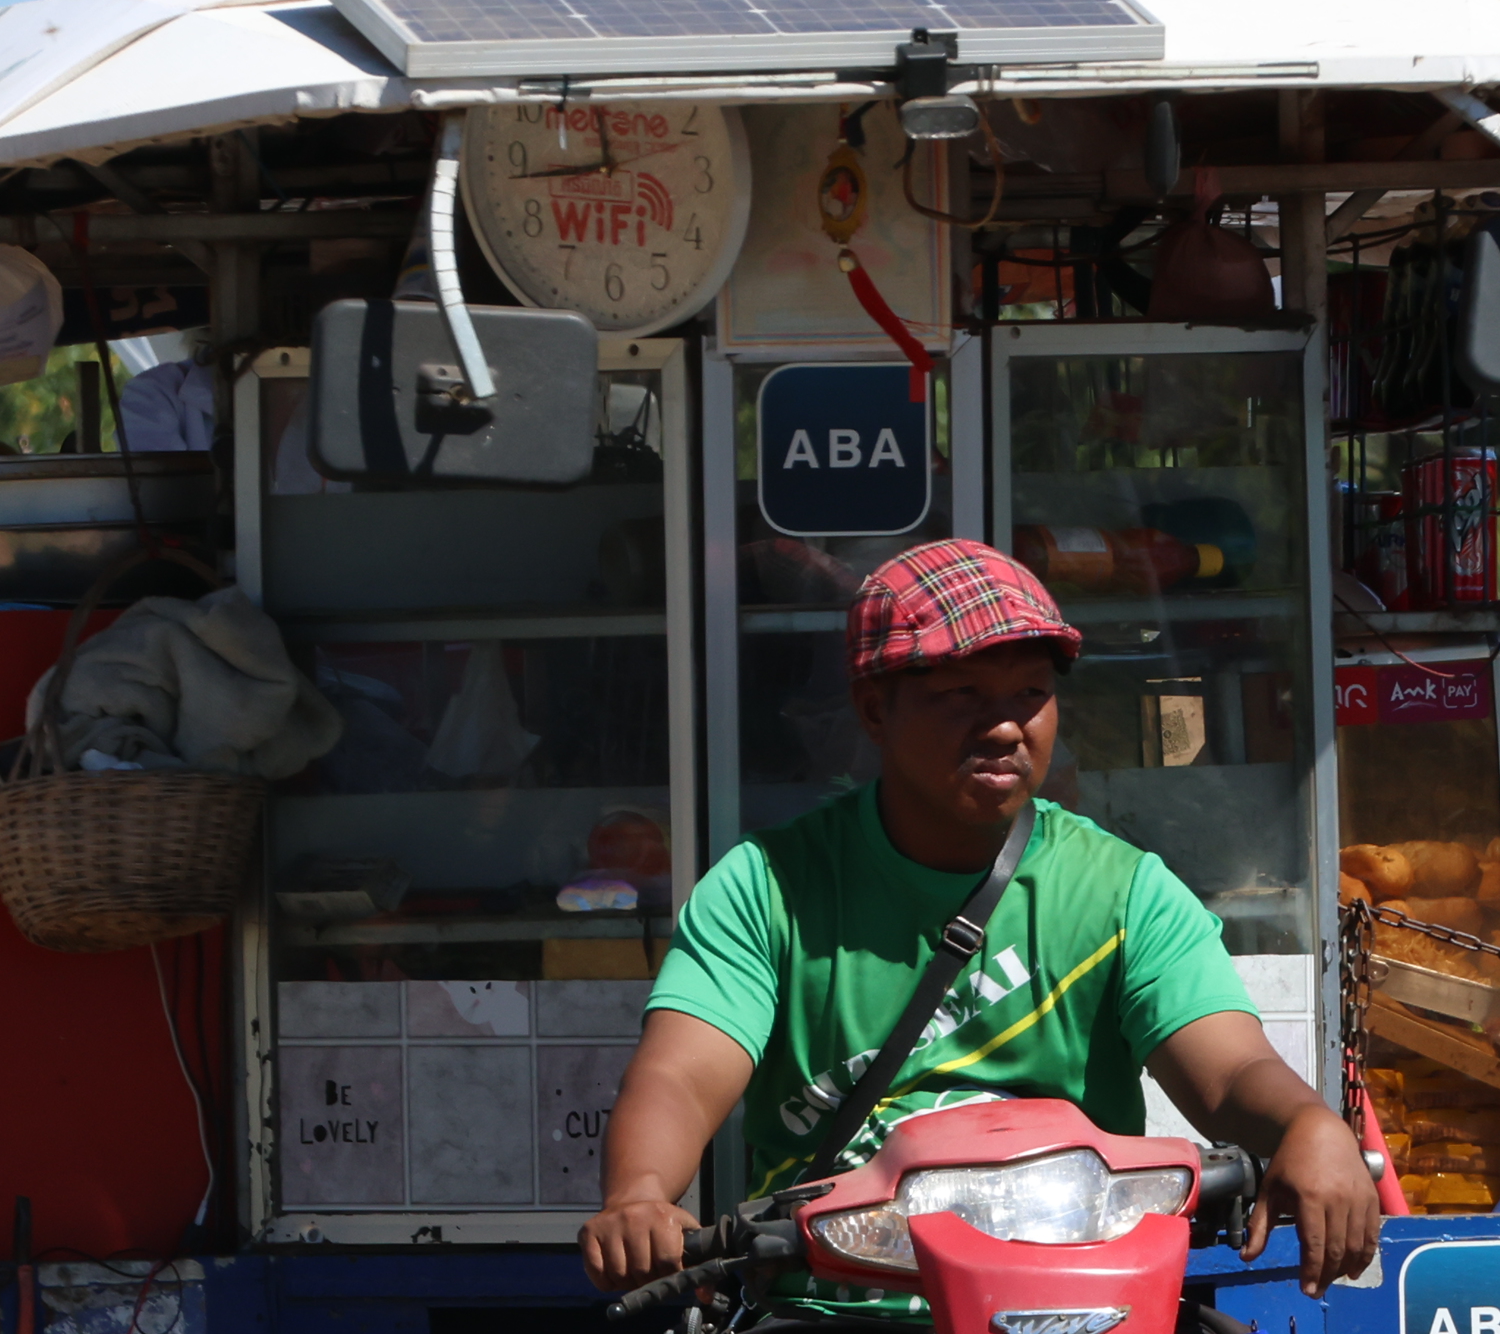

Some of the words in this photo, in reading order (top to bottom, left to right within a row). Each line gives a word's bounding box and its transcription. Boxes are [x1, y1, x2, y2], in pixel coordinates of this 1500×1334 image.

[508, 141, 527, 177] 9
[694, 156, 714, 194] 3
[523, 199, 543, 237] 8
[683, 213, 703, 251] 4
[558, 244, 576, 281] 7
[652, 252, 670, 291] 5
[605, 263, 624, 302] 6
[782, 427, 906, 469] ABA
[1447, 684, 1472, 698] PAY
[325, 1079, 352, 1107] BE
[299, 1119, 379, 1145] LOVELY
